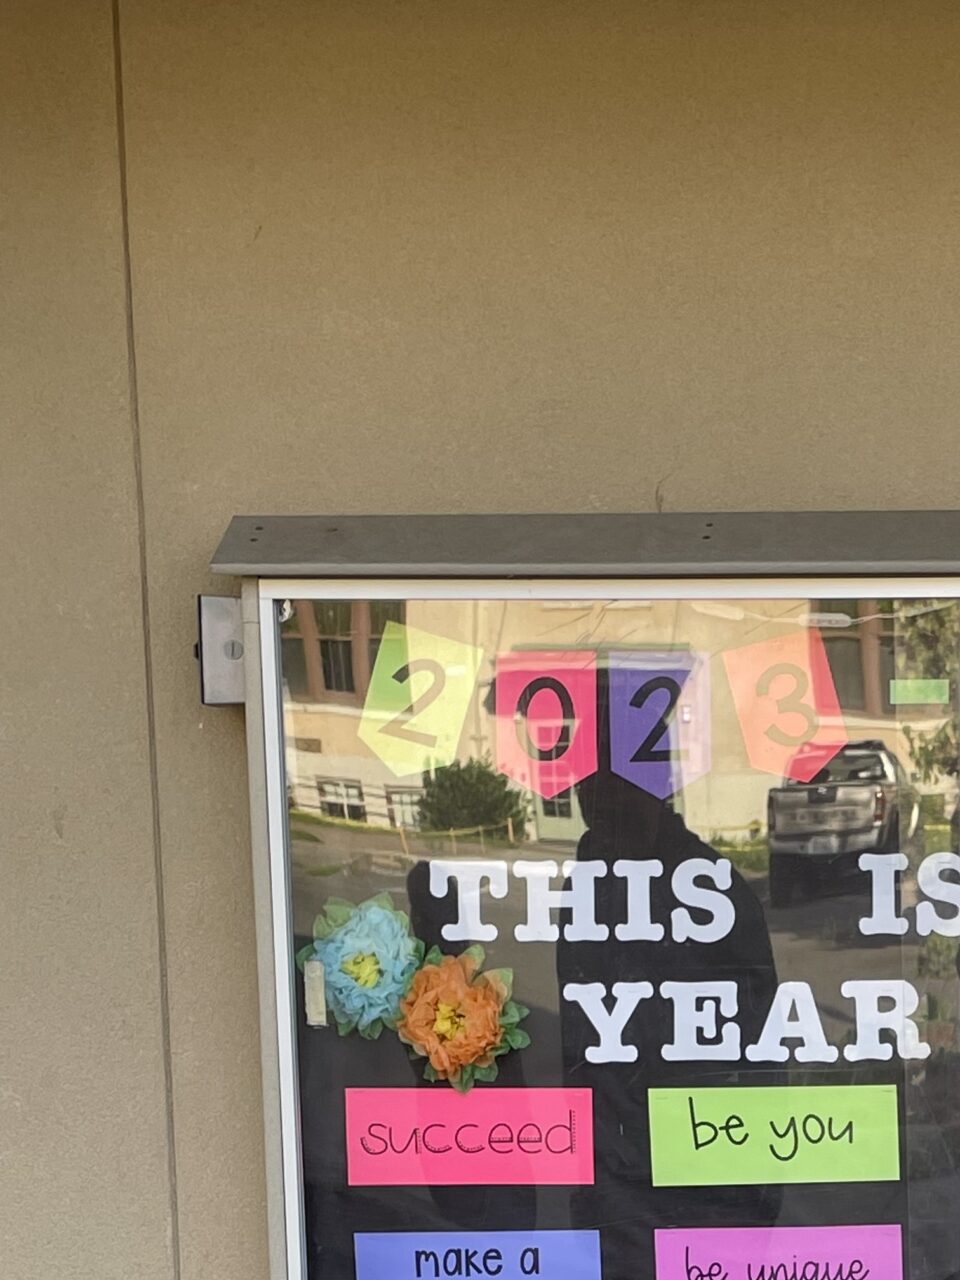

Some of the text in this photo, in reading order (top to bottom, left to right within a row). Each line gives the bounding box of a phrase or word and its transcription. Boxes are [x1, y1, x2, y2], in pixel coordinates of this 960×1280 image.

[377, 658, 820, 762] 2023
[429, 858, 735, 943] THIS
[563, 980, 931, 1062] YEAR
[360, 1109, 577, 1155] succeed
[688, 1097, 854, 1162] be you
[414, 1246, 541, 1277] make a
